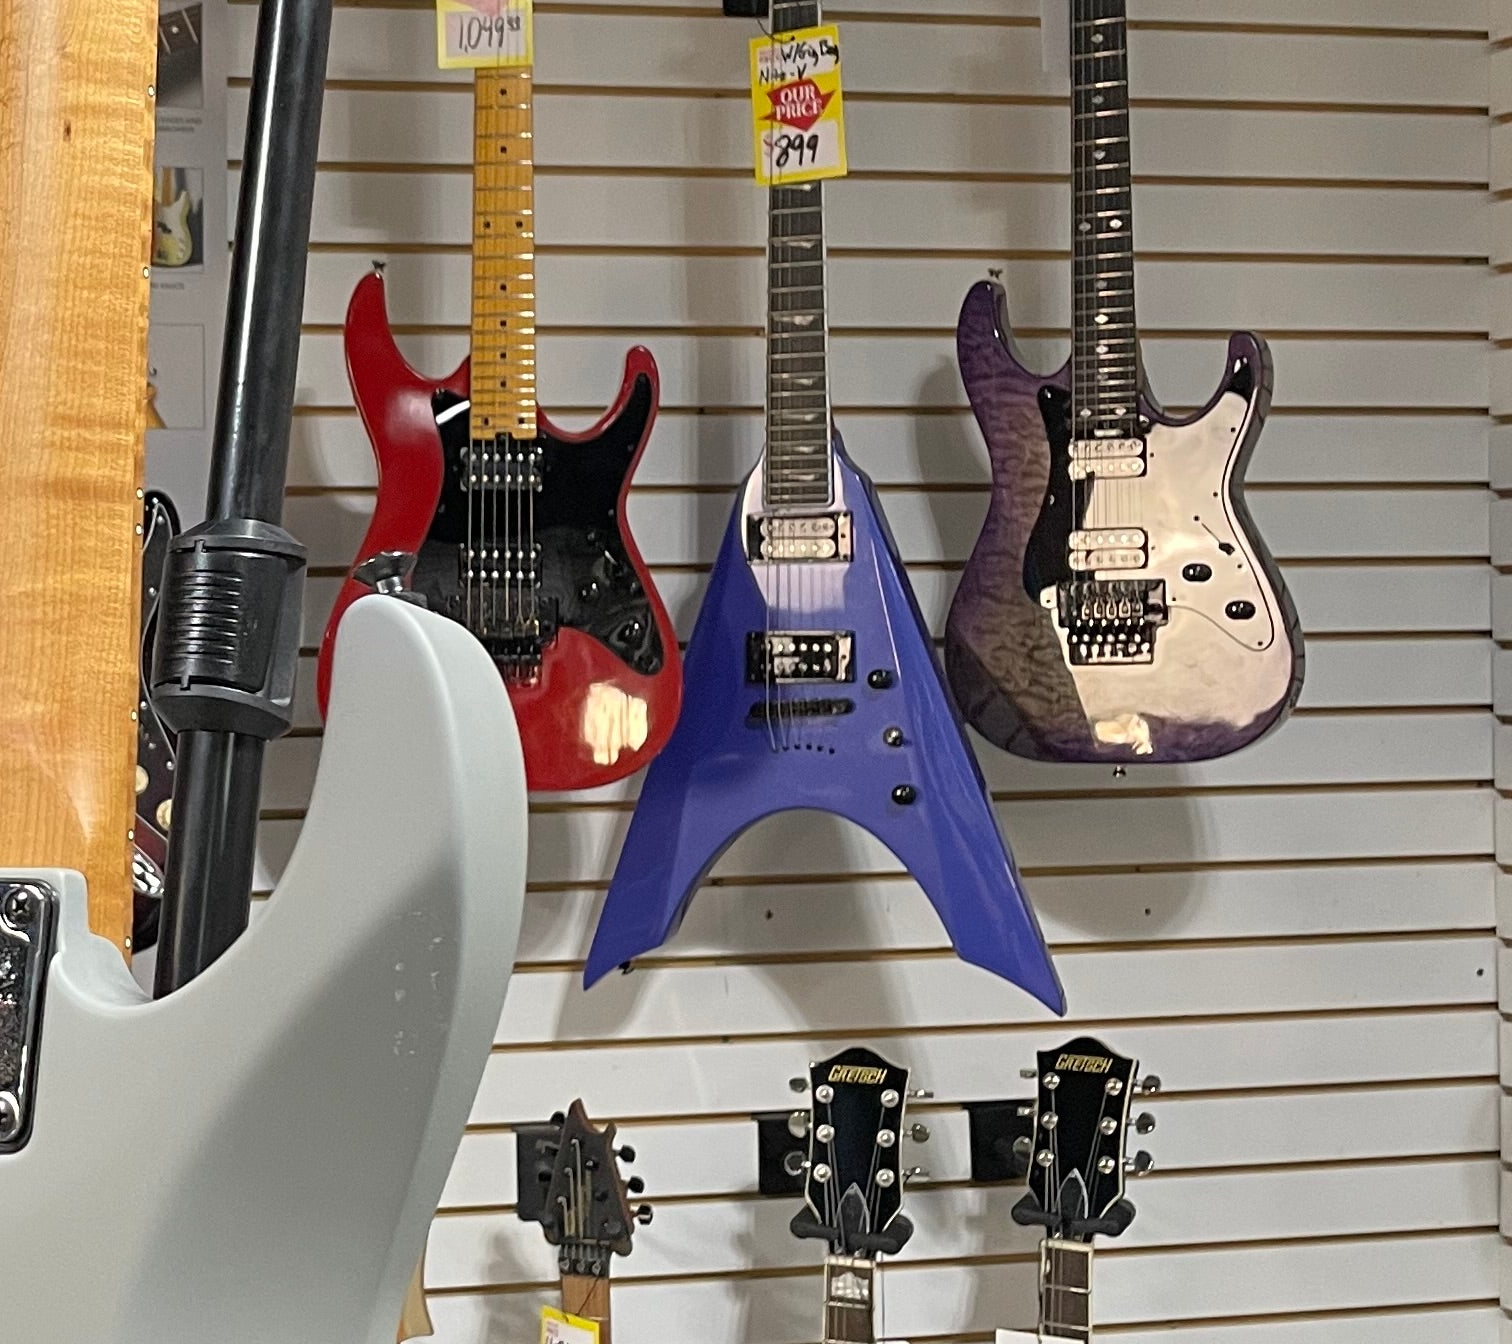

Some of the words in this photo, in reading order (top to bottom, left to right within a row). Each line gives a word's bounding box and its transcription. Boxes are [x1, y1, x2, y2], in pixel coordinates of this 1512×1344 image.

[779, 83, 816, 105] OUR
[775, 97, 824, 121] PRICE
[1055, 1053, 1114, 1074] GRETSCH
[828, 1064, 888, 1085] GRETSCH
